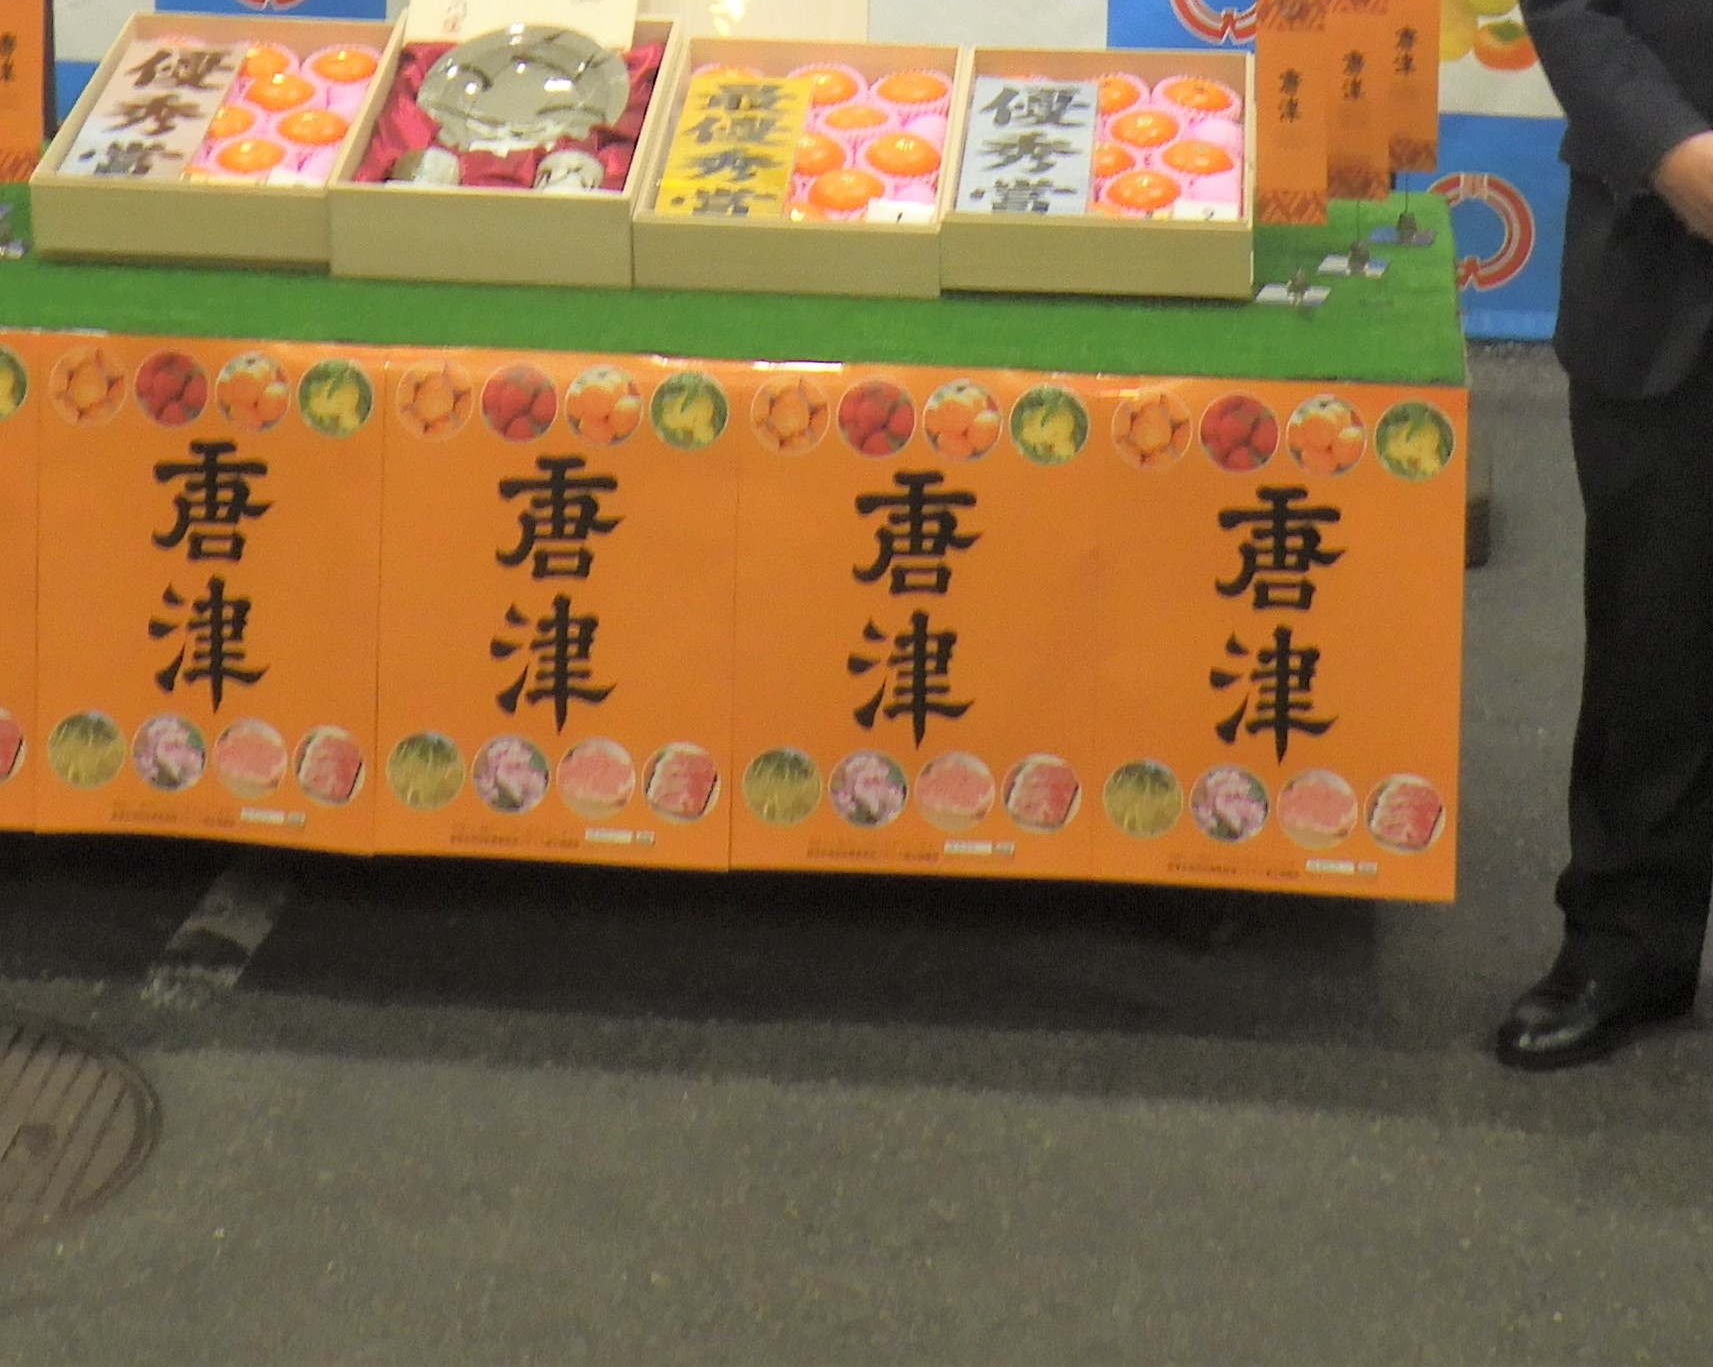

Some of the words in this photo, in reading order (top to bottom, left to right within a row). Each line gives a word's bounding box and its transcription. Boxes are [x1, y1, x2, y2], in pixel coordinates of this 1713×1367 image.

[148, 440, 272, 715] 唐津
[490, 456, 623, 735] 唐津
[847, 471, 982, 750] 唐津
[1209, 486, 1345, 764] 唐津
